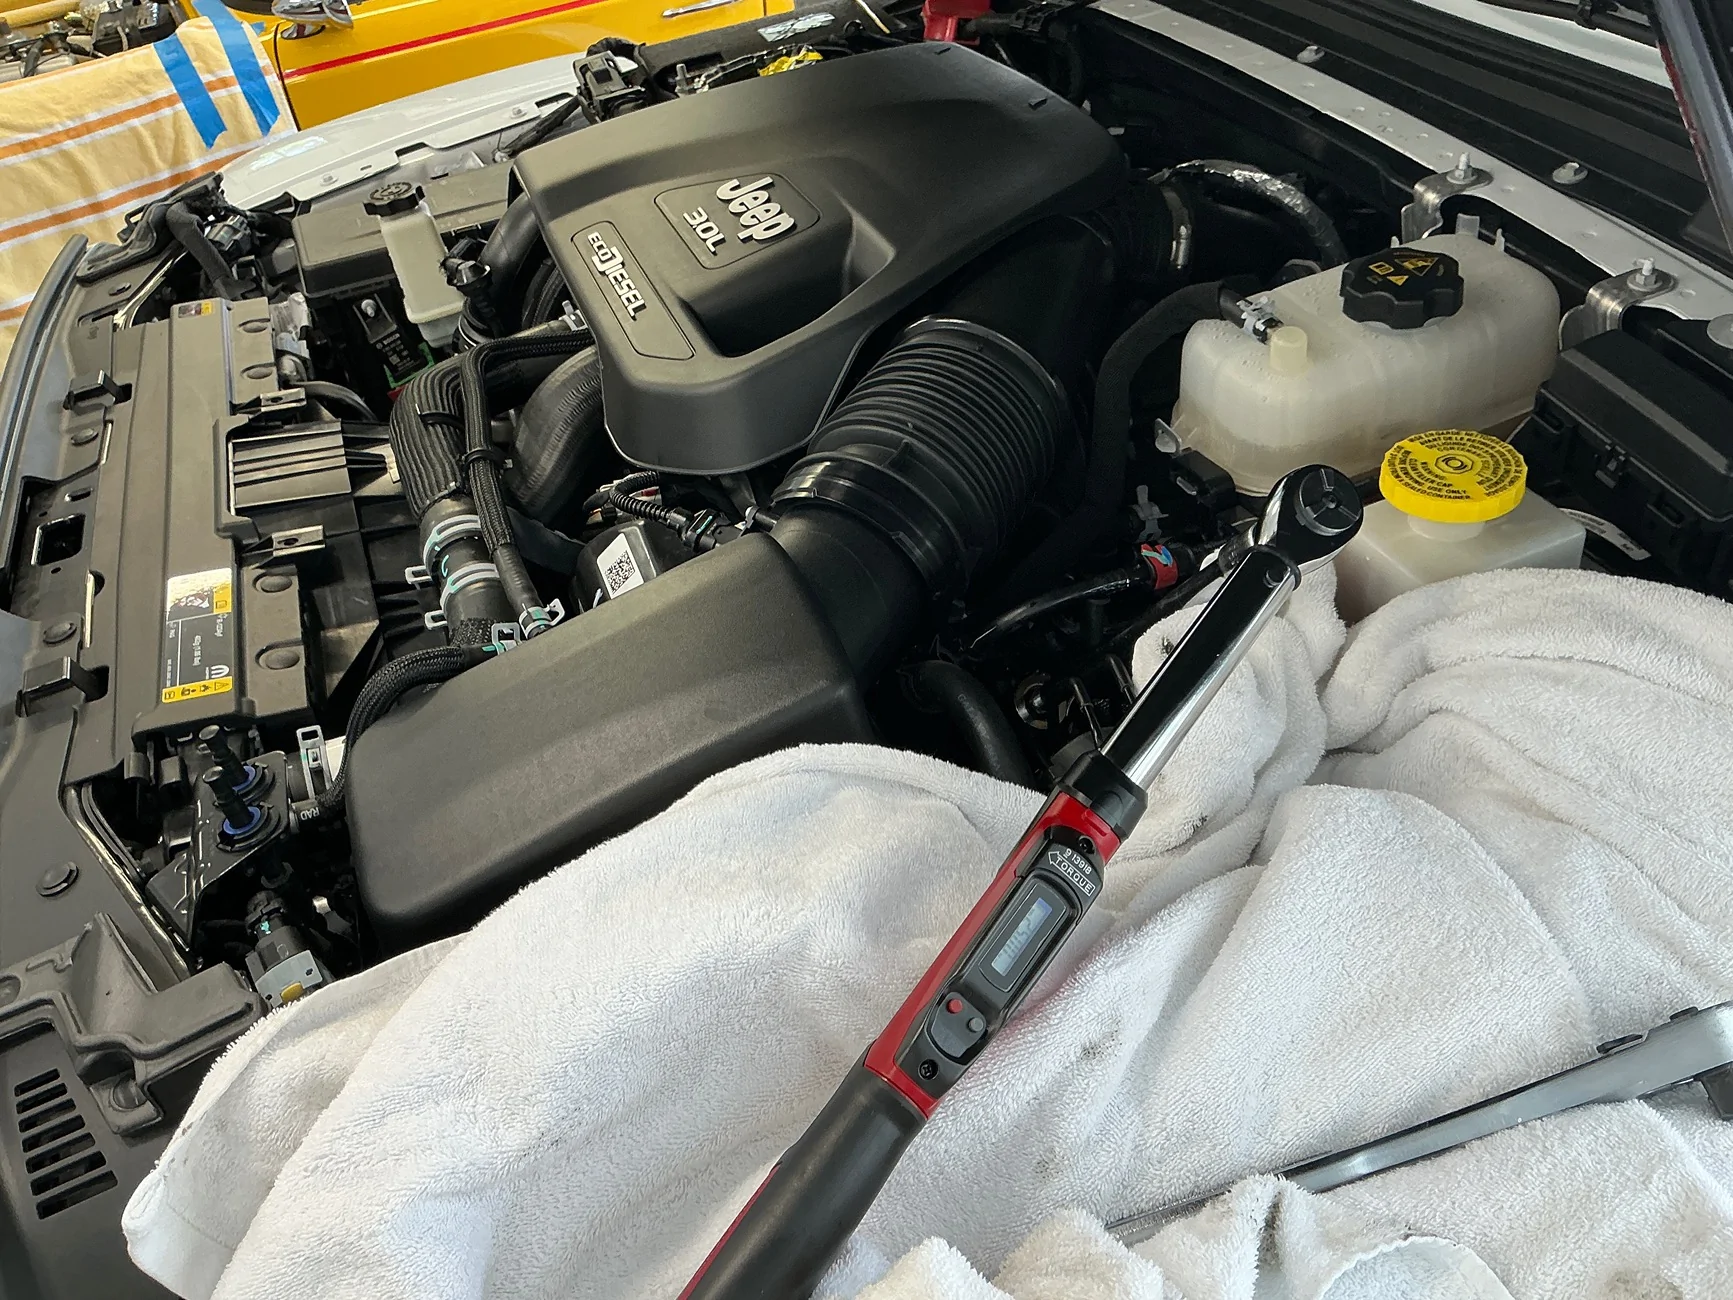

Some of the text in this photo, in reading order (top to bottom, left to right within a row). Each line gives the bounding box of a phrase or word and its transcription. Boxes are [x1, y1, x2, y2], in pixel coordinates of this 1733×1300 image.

[716, 176, 795, 240] Jeep
[683, 206, 726, 253] 3.0L
[300, 806, 320, 820] RAD
[1055, 855, 1093, 893] TORQUE
[1071, 853, 1092, 875] 13918
